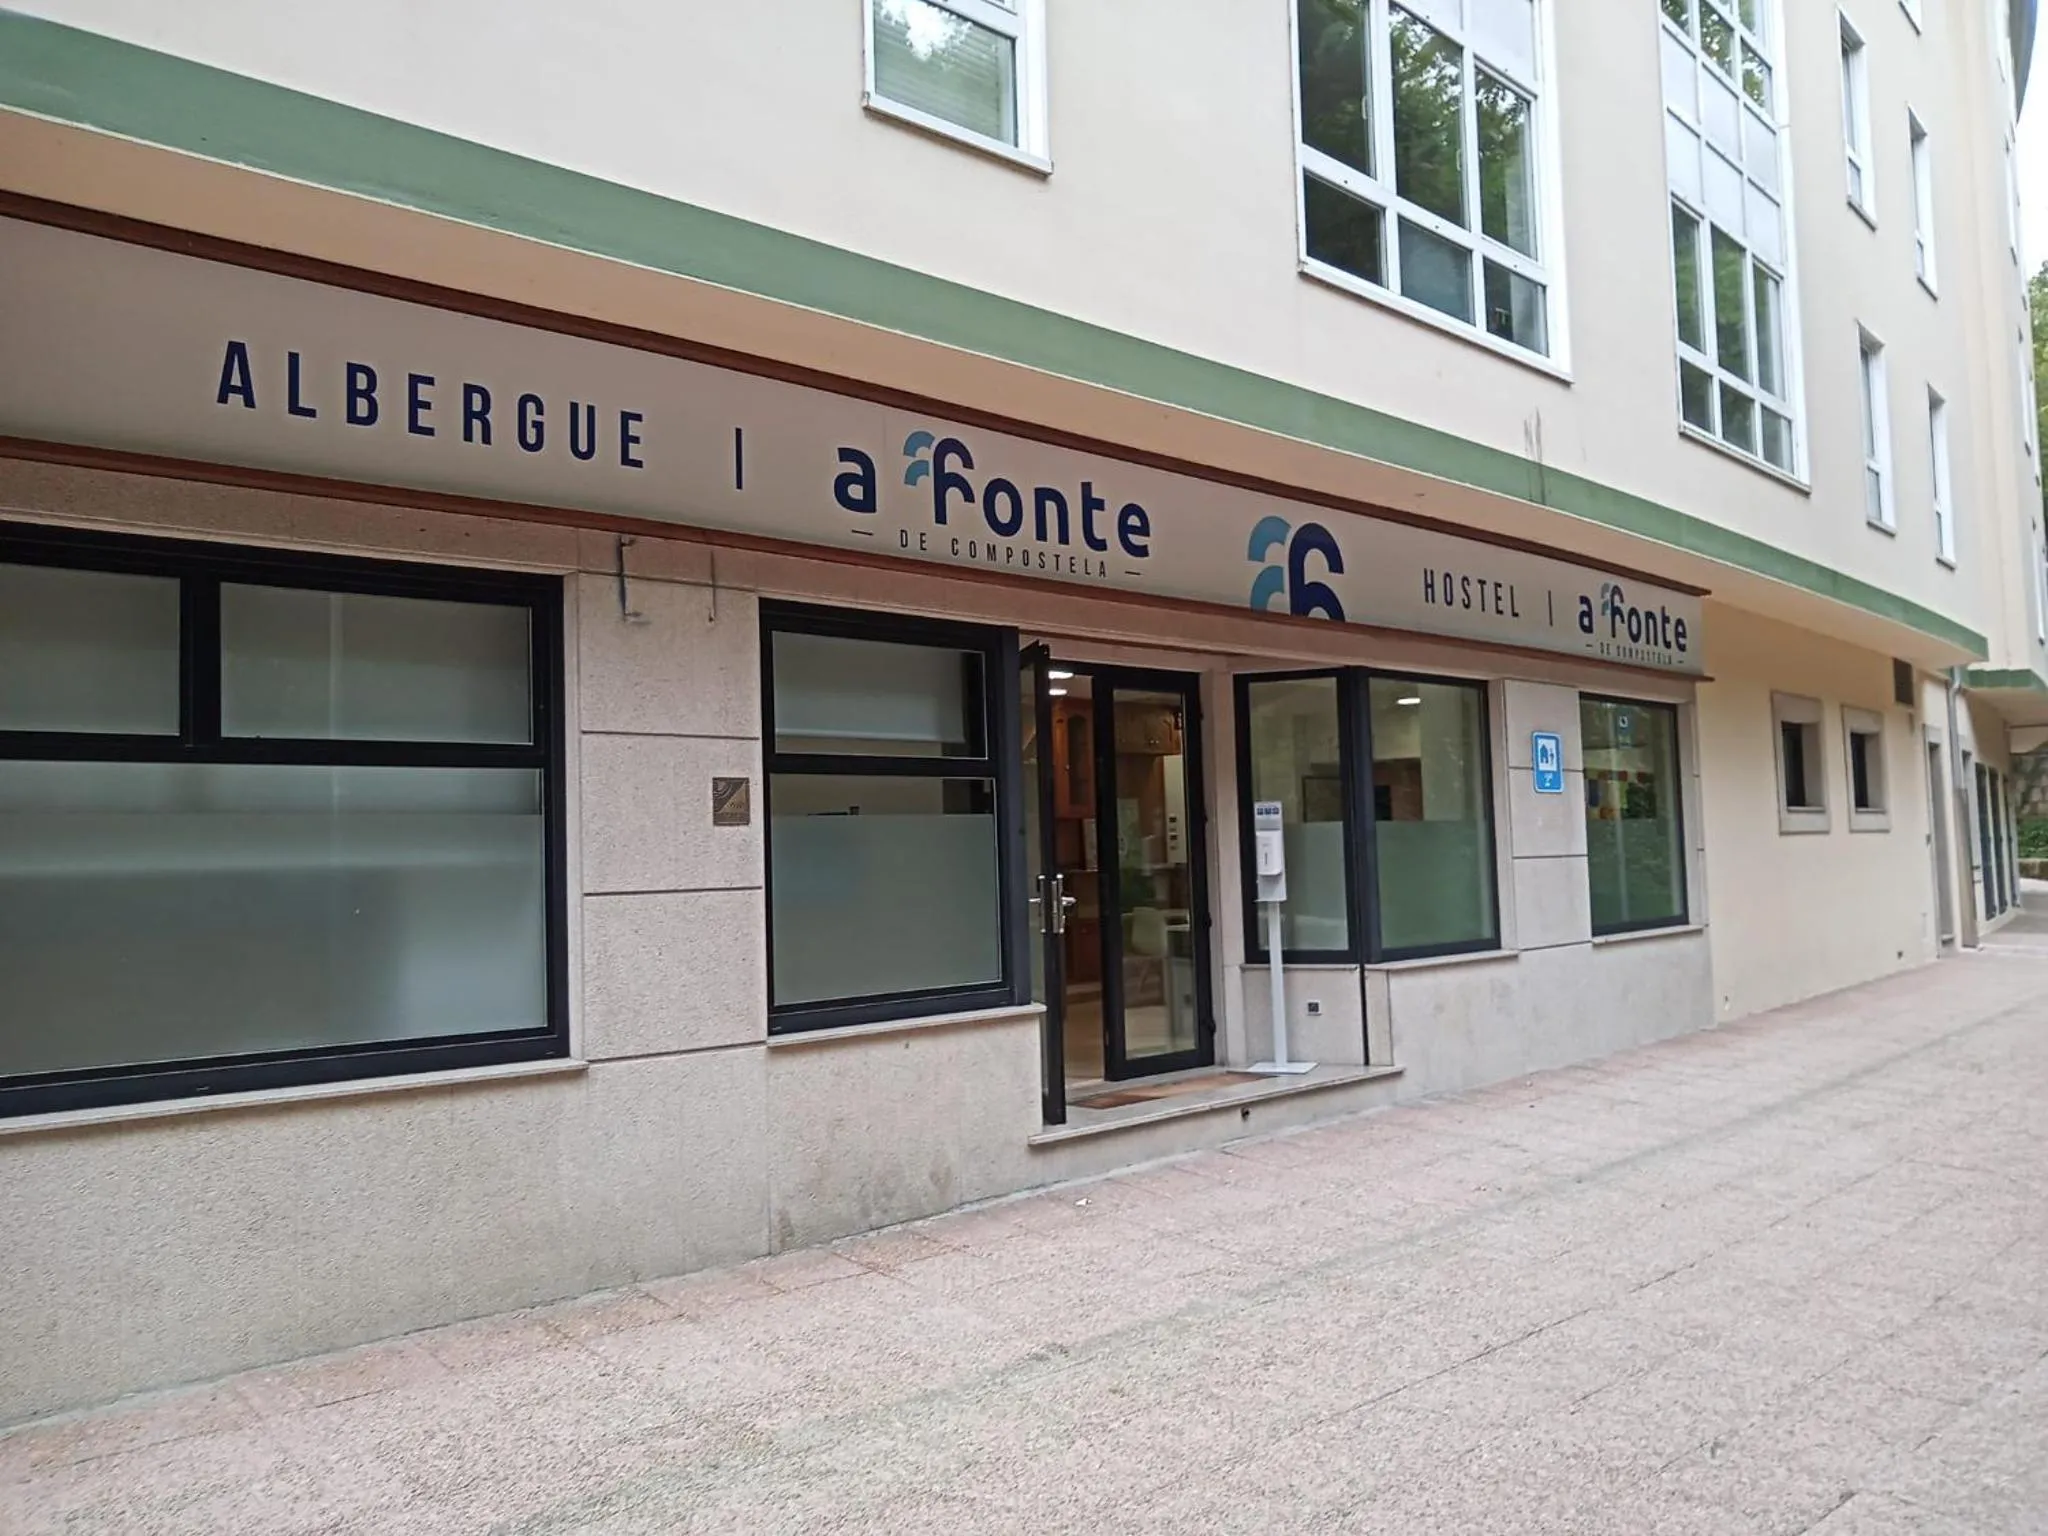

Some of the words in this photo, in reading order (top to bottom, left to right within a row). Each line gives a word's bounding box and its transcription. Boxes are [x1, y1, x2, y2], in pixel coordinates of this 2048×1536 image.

[216, 340, 645, 469] ALBERGUE
[833, 447, 877, 514] a
[932, 437, 1150, 558] fonte
[899, 529, 928, 551] DE
[950, 537, 1109, 578] COMPOSTELA
[1423, 567, 1520, 618] HOSTEL
[1578, 595, 1594, 634] a
[1610, 585, 1687, 652] fonte
